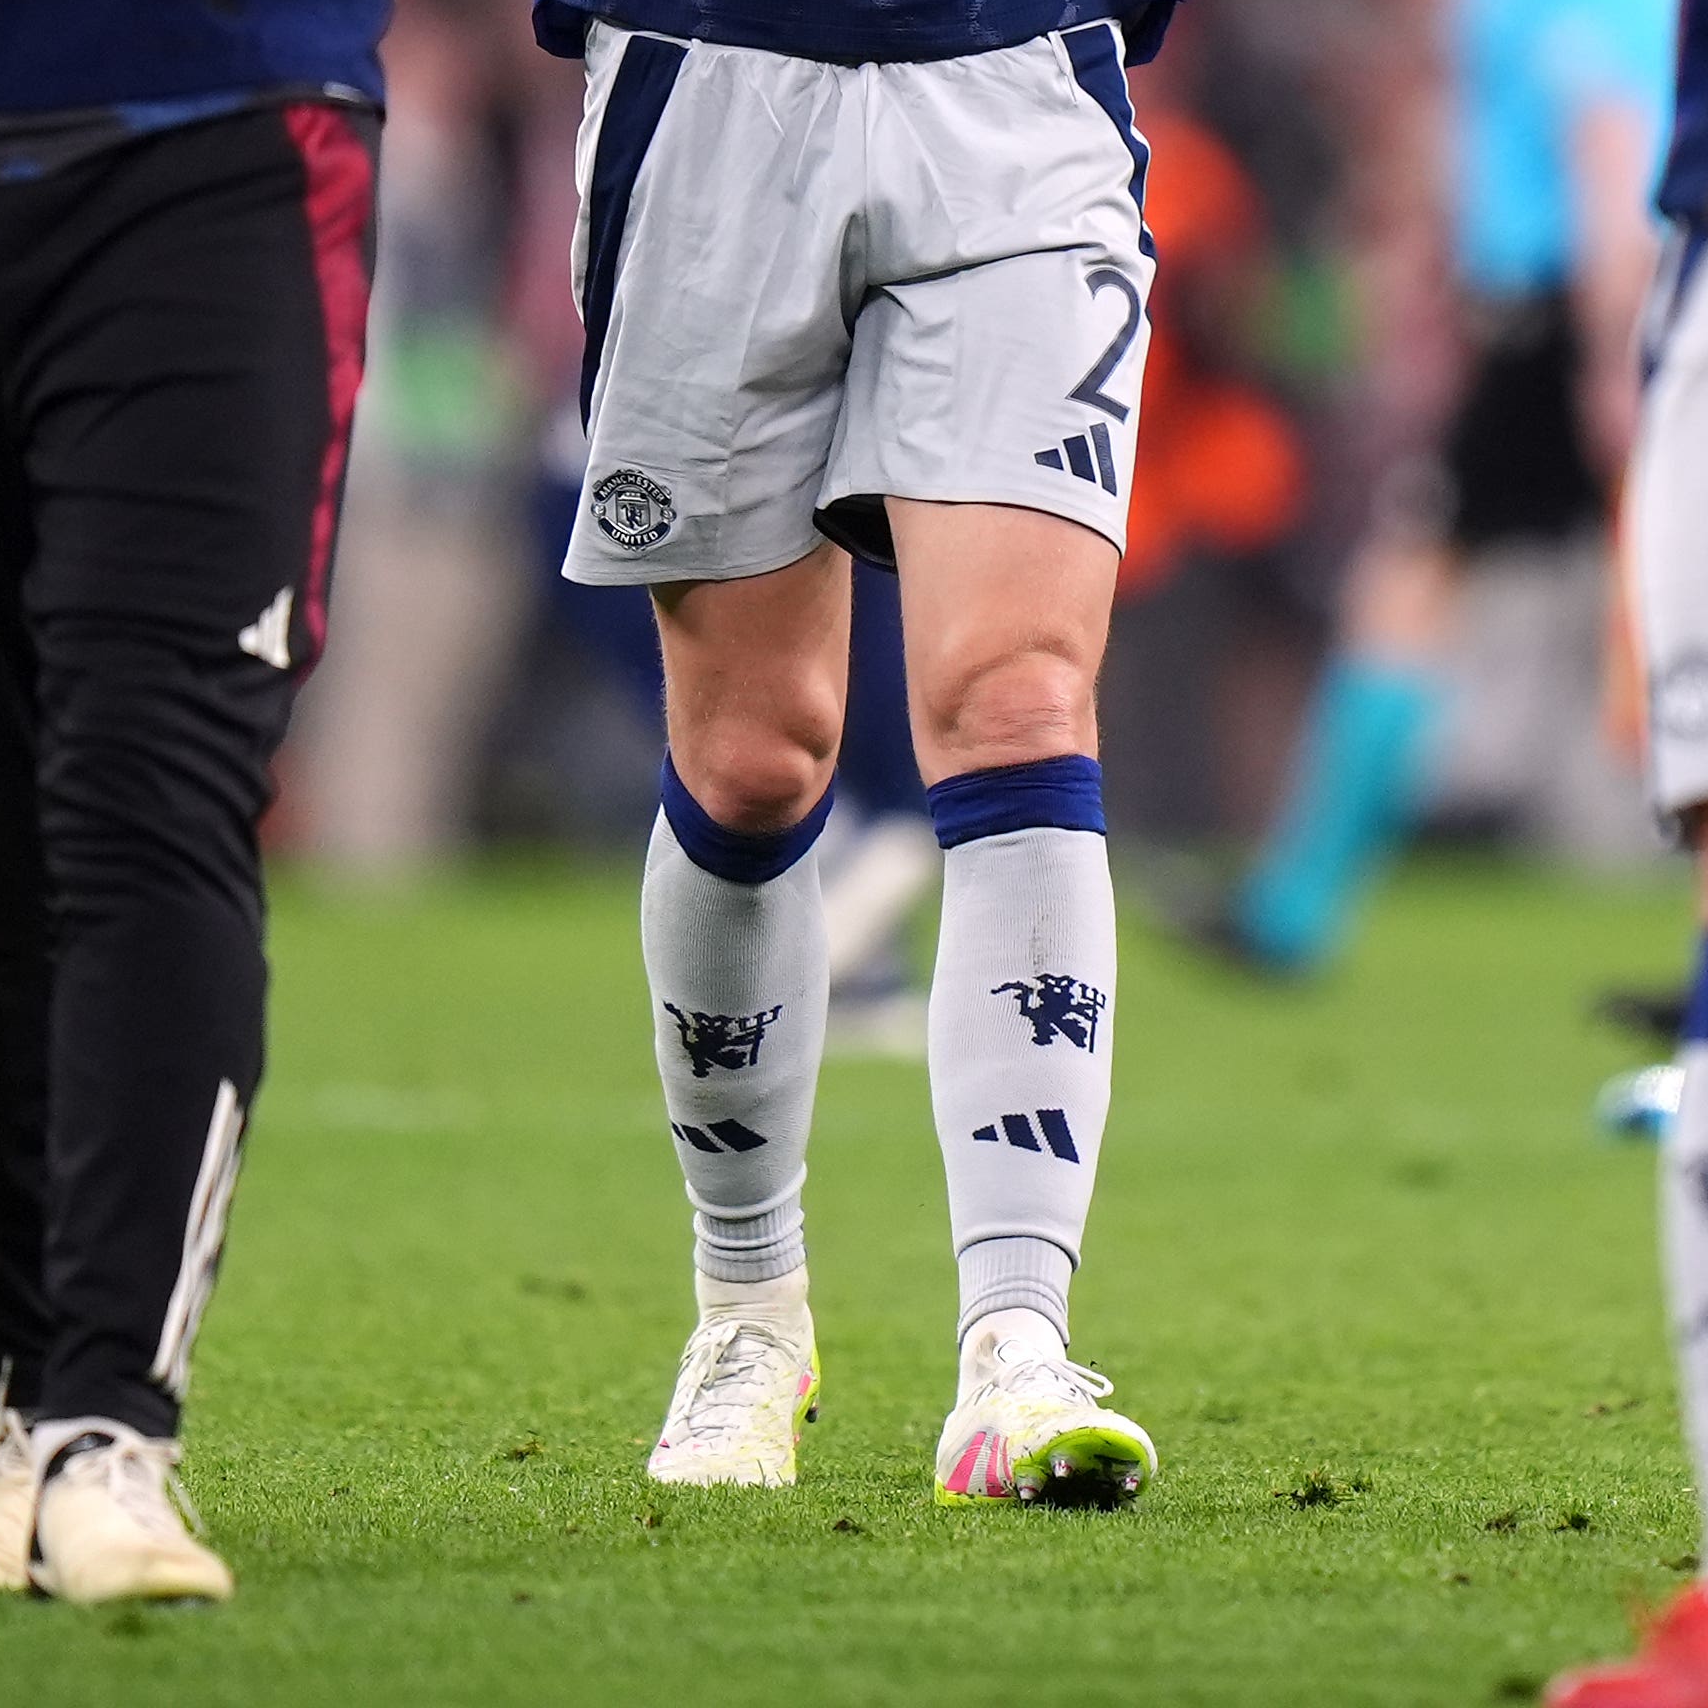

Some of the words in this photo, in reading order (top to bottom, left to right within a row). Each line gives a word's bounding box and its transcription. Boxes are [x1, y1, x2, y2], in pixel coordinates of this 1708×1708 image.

[1065, 265, 1141, 424] 2
[599, 474, 665, 503] MANCHESTER
[611, 528, 659, 544] UNITED
